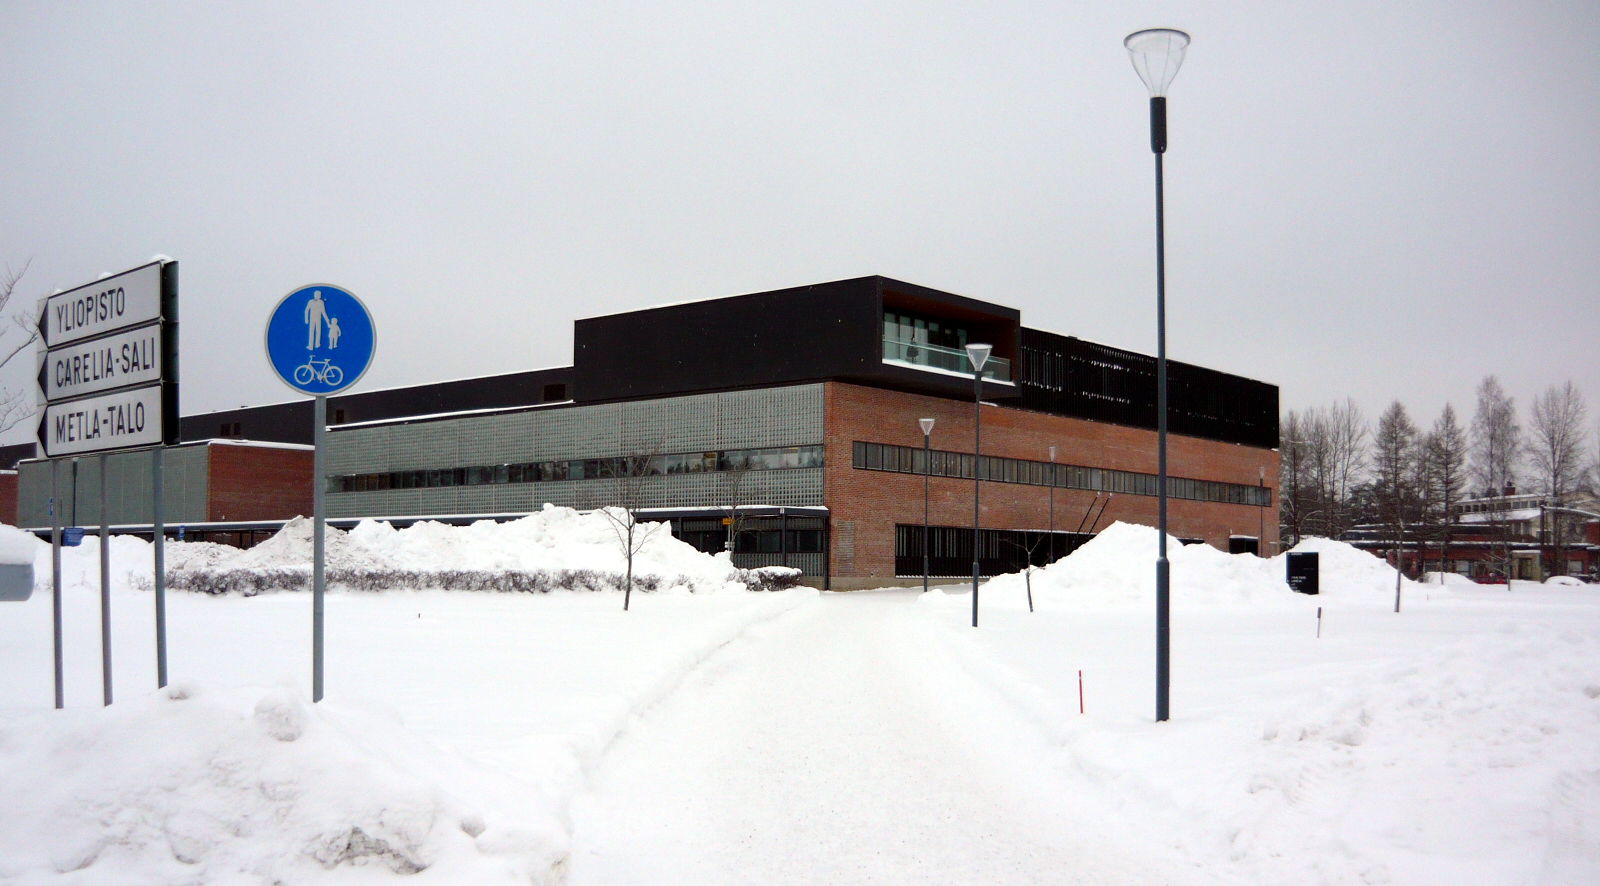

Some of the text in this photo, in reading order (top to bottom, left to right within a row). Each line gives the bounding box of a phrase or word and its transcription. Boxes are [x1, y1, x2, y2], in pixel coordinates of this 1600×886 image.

[56, 287, 125, 333] YLIOPISTO
[56, 337, 155, 388] CARELIA-SALI
[56, 401, 145, 444] METLA-TALO
